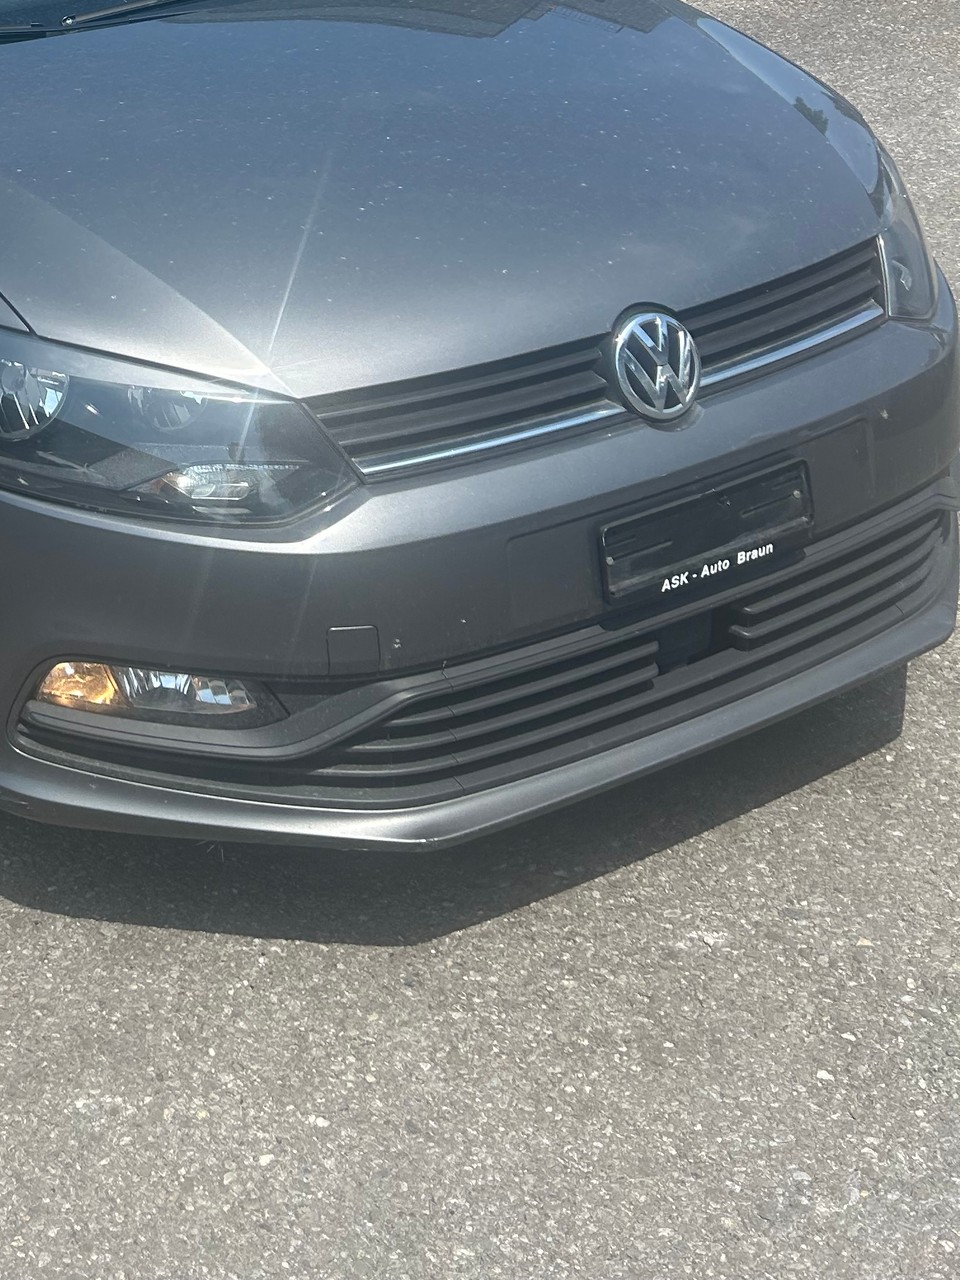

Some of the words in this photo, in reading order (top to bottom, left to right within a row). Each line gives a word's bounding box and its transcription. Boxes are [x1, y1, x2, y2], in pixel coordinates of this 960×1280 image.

[618, 315, 696, 417] VW
[661, 572, 689, 592] ASK
[701, 558, 730, 578] Auto
[737, 543, 773, 565] Braun
